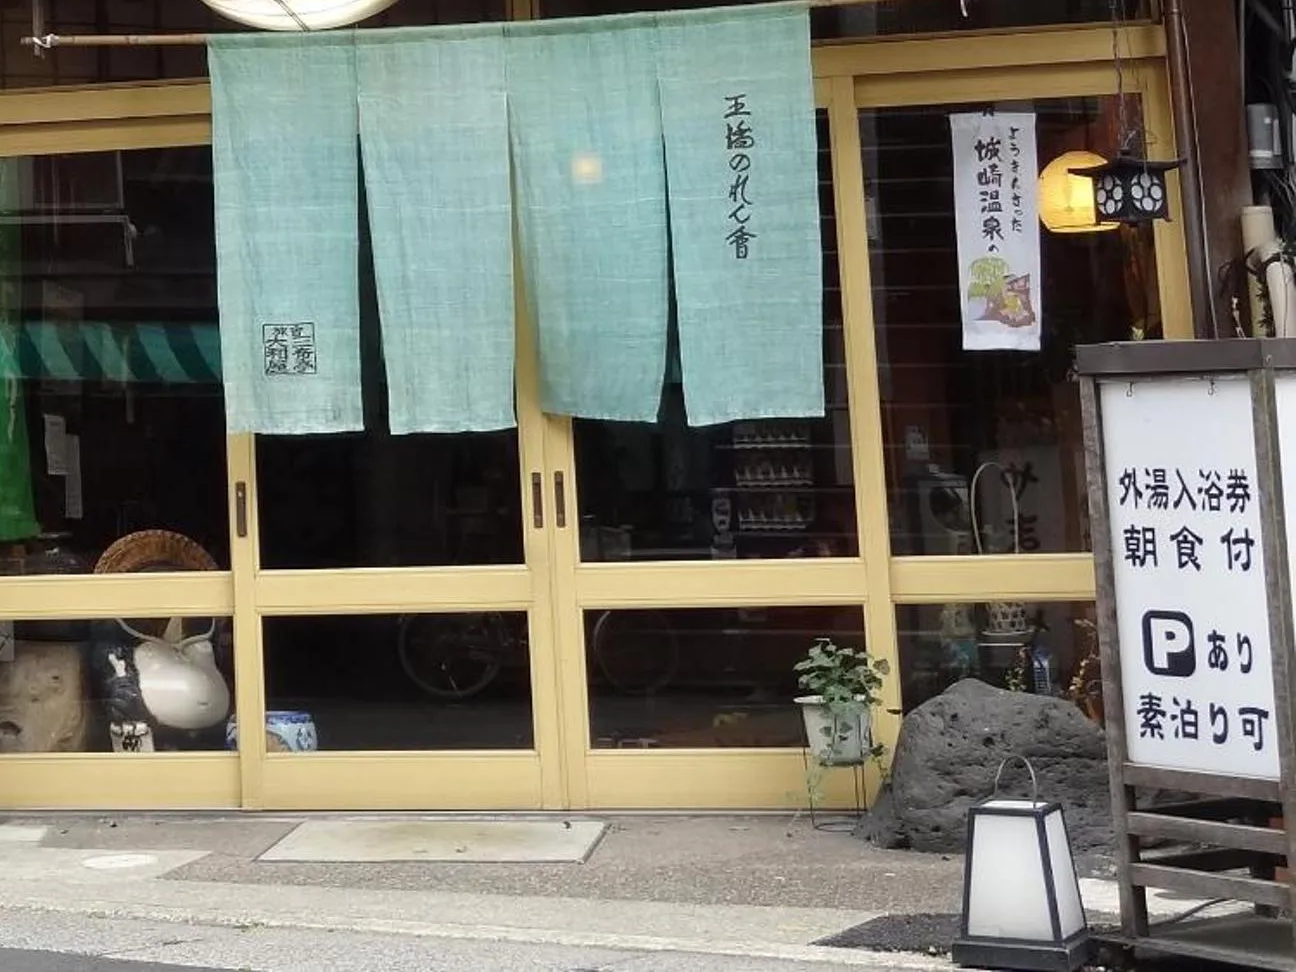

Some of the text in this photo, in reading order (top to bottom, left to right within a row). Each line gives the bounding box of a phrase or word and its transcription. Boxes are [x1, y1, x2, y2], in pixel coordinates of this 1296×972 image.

[1119, 467, 1251, 513] 外湯入浴券
[1123, 524, 1255, 572] 朝食付
[1207, 629, 1253, 674] あり
[1137, 692, 1269, 751] 素泊り可
